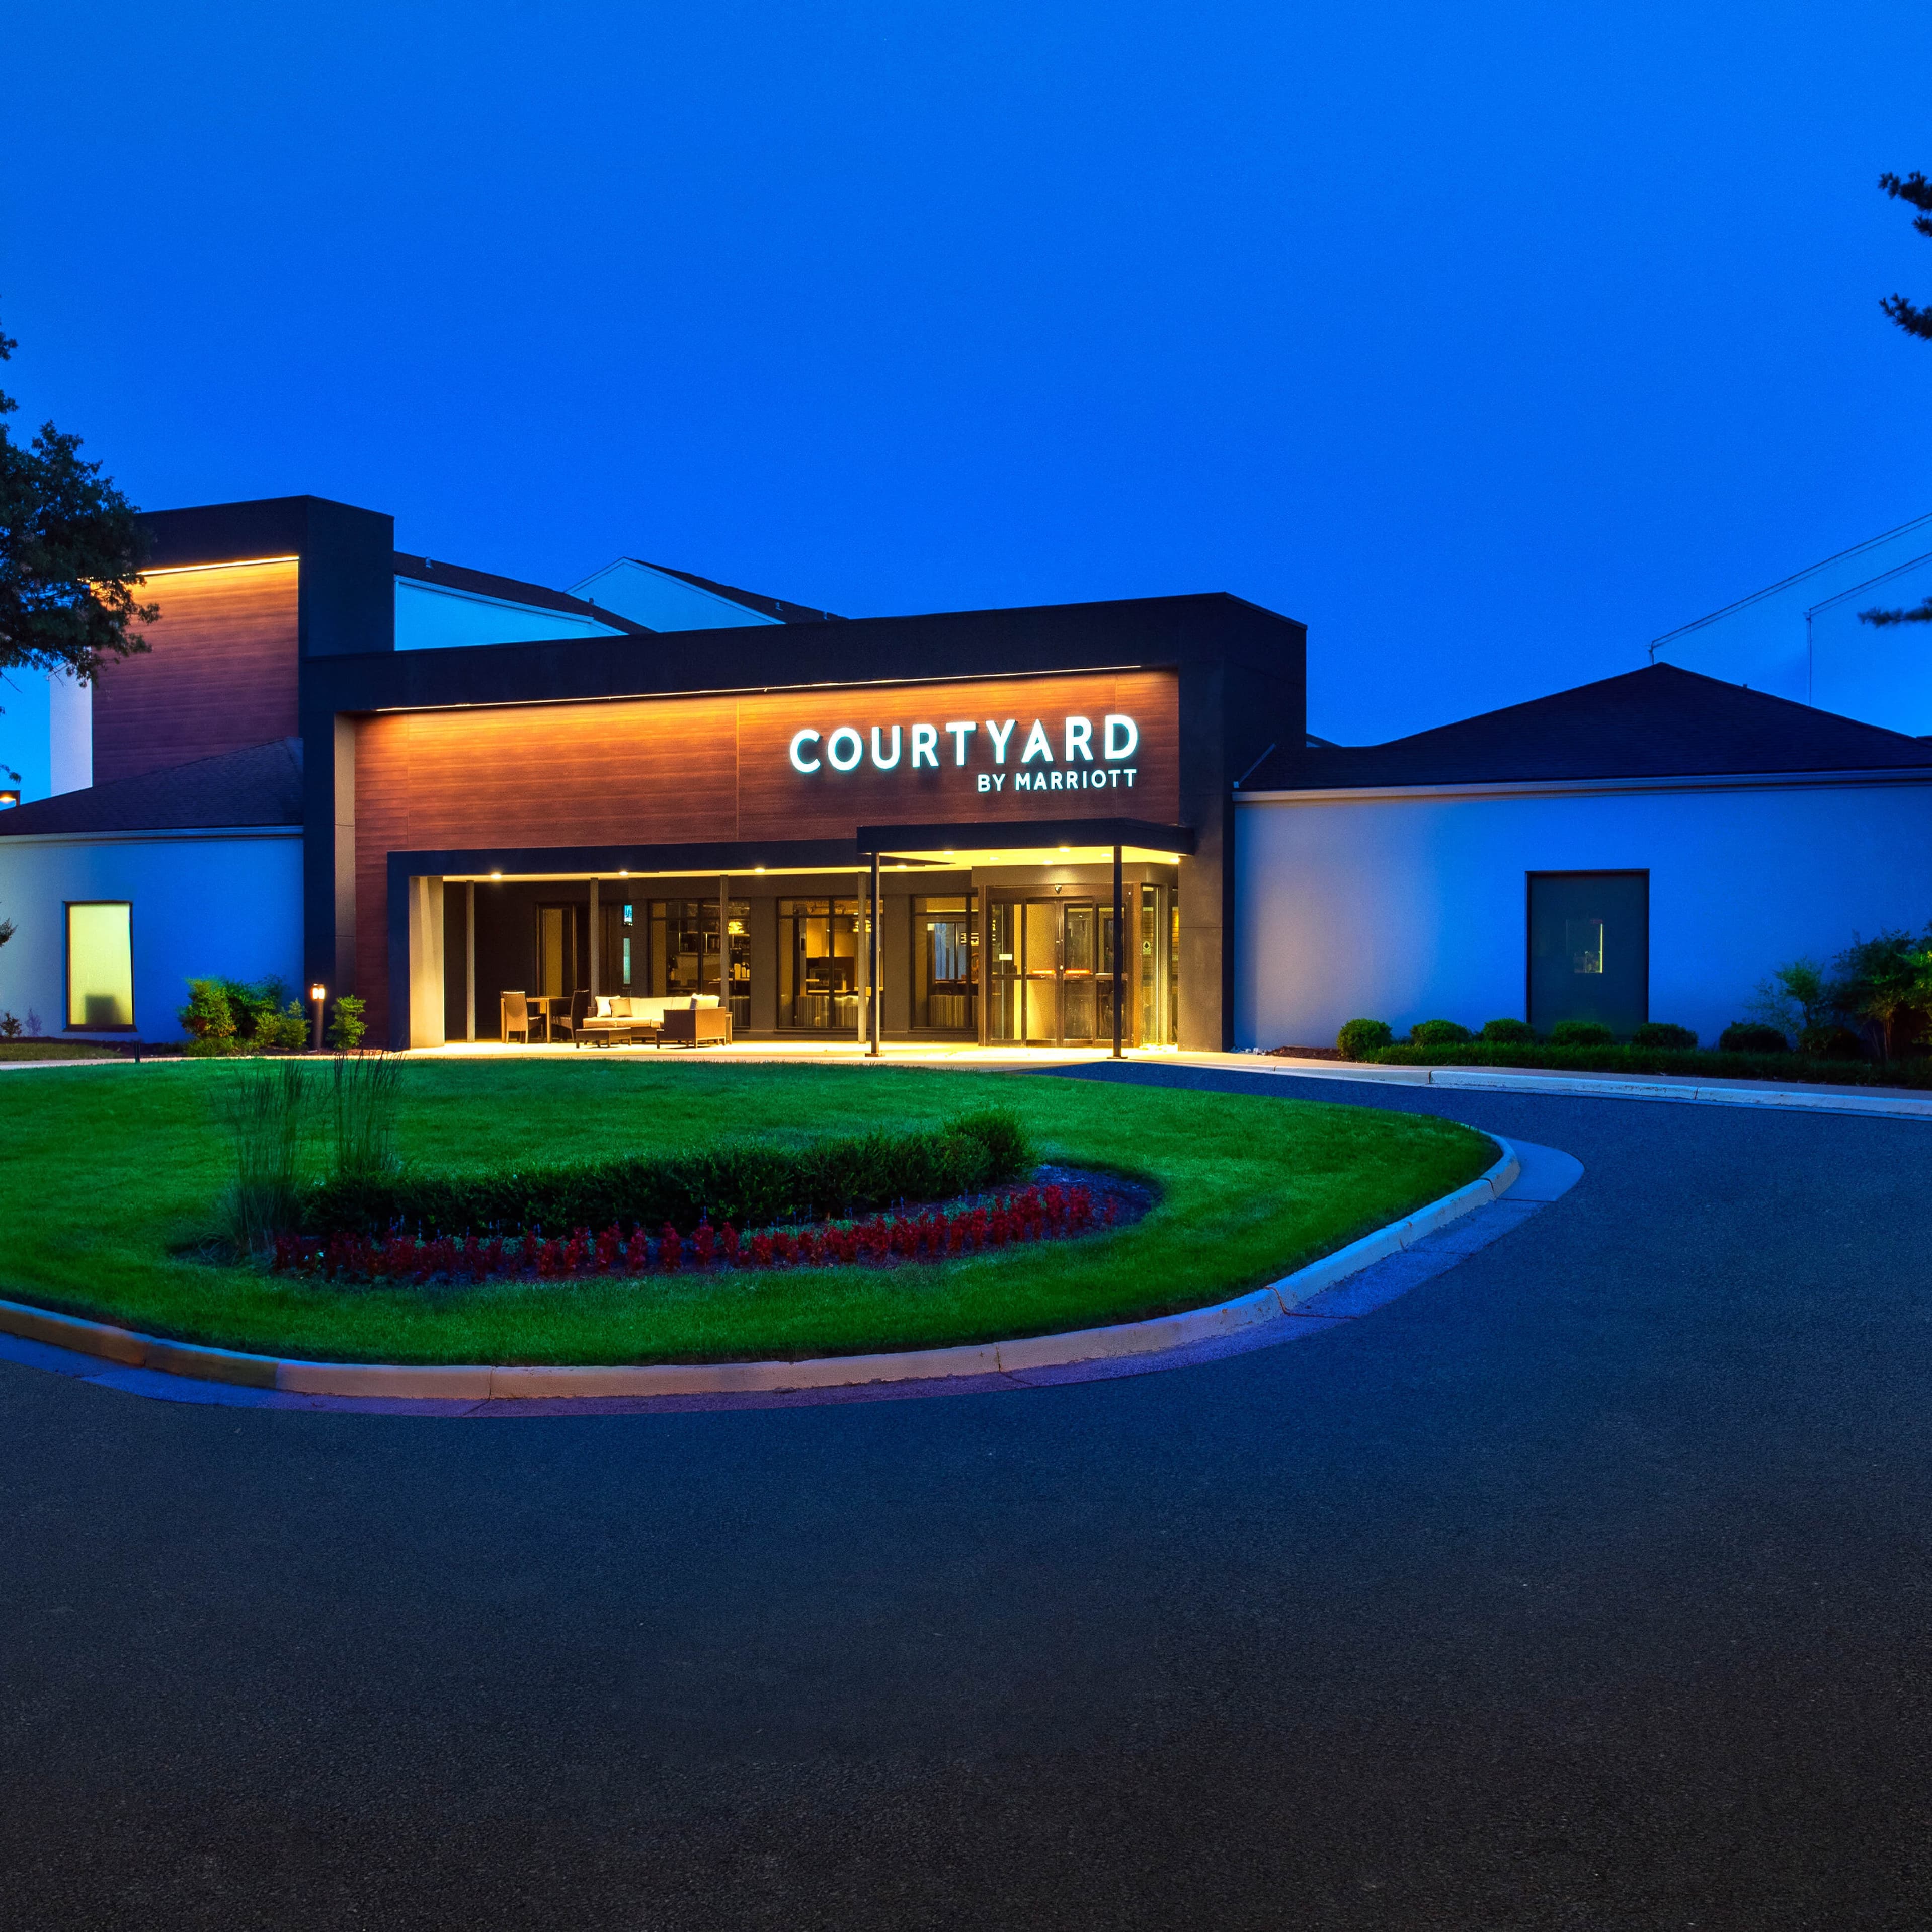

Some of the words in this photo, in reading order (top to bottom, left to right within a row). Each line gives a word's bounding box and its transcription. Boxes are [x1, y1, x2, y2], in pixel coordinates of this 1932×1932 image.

[789, 714, 1138, 773] COURTYARD
[978, 774, 1006, 792] BY
[1015, 769, 1137, 791] MARRIOTT
